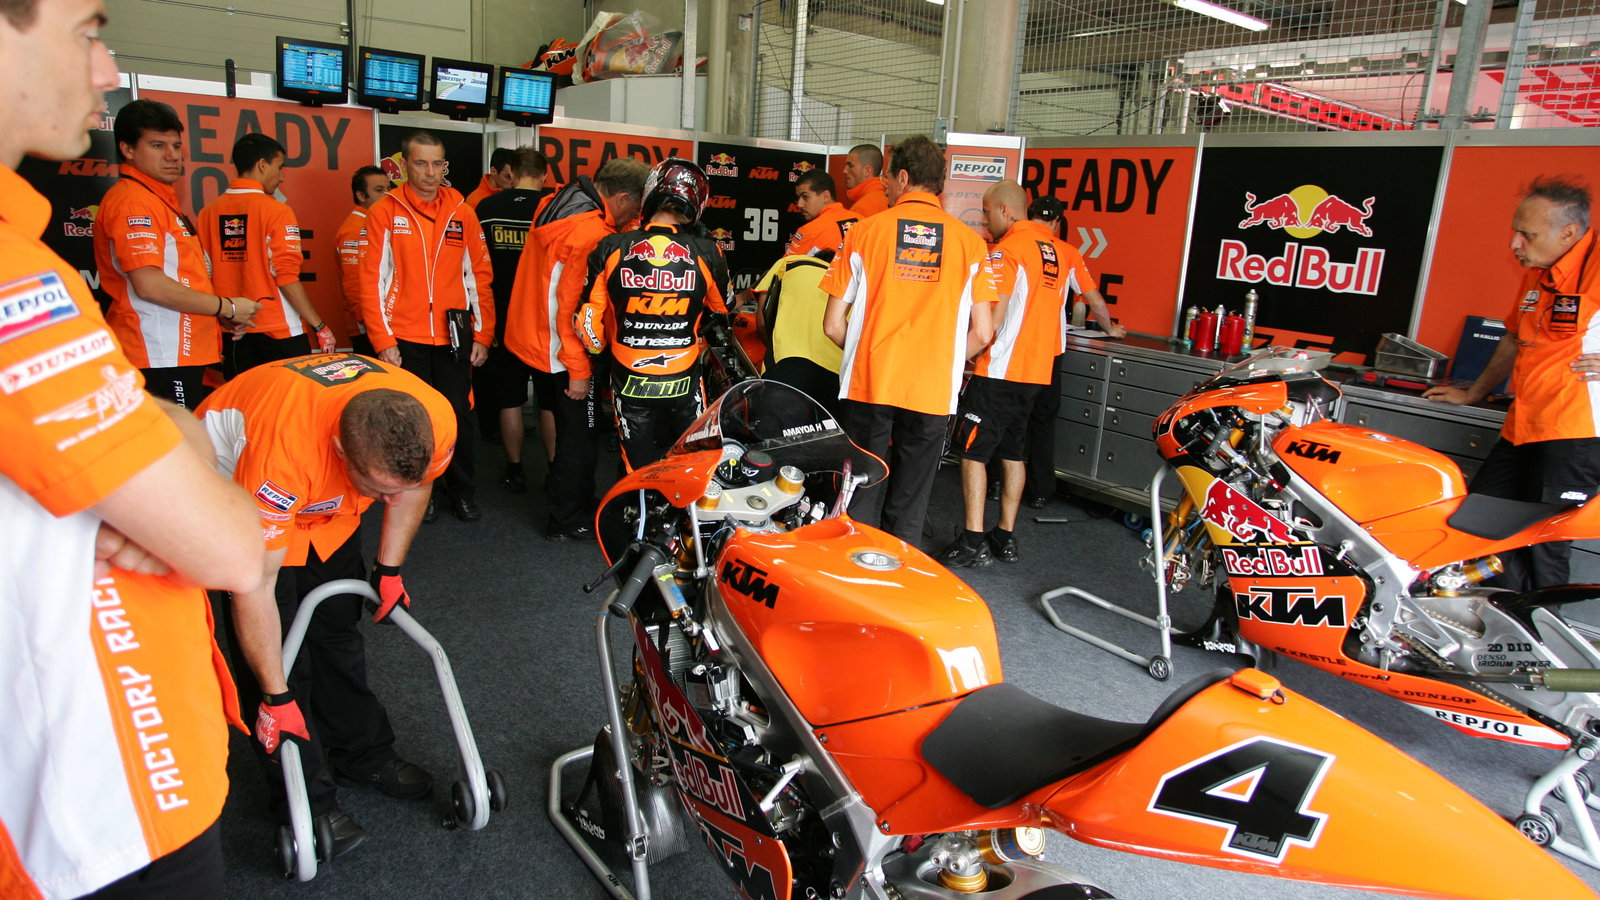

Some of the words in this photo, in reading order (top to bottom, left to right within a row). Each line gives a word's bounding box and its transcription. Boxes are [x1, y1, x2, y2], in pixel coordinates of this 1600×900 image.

[706, 164, 722, 176] Red
[722, 166, 738, 178] Bull
[748, 166, 779, 181] KTM
[953, 163, 1003, 174] REPSOL
[1022, 158, 1175, 215] READY
[743, 207, 779, 242] 36
[898, 247, 939, 263] KTM
[1216, 238, 1299, 287] Red
[1295, 245, 1386, 296] Bull
[620, 268, 659, 290] Red
[659, 269, 697, 291] Bull
[0, 288, 69, 321] EPSOL
[626, 292, 691, 316] KTM
[634, 321, 689, 330] DUNLOP
[623, 335, 691, 347] alpinestars
[27, 335, 110, 377] DUNLOP
[587, 401, 595, 428] RACING
[1285, 439, 1341, 464] KTM
[261, 487, 292, 507] REPSOL
[1221, 547, 1271, 576] Red
[1267, 546, 1324, 576] Bull
[720, 557, 780, 609] KTM
[1235, 586, 1348, 629] KTM
[1487, 643, 1503, 652] 2D
[1516, 660, 1551, 668] POWER
[1402, 690, 1477, 704] DUNLOP
[1435, 709, 1523, 737] REPSOL
[117, 665, 189, 812] FACTORY
[674, 750, 702, 799] ed
[692, 755, 746, 821] Bull
[1146, 735, 1337, 864] 4
[1232, 831, 1278, 853] KTM
